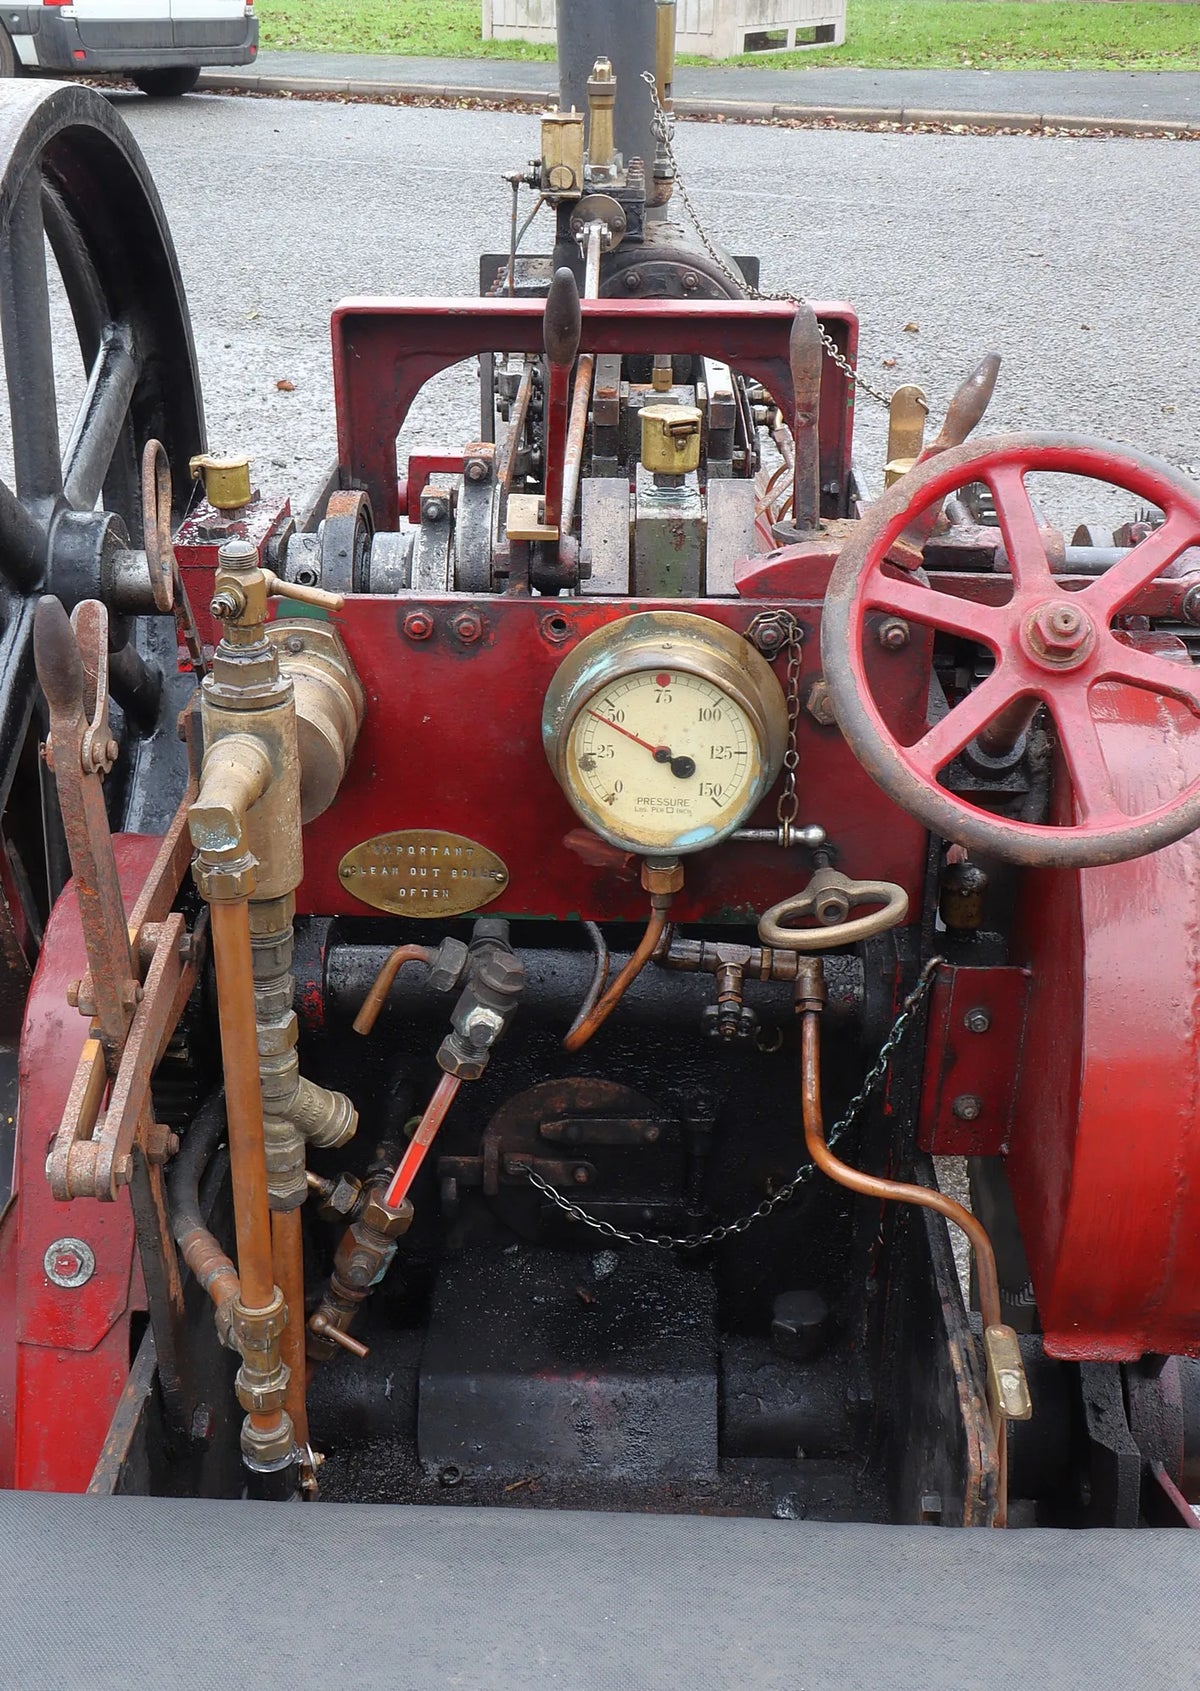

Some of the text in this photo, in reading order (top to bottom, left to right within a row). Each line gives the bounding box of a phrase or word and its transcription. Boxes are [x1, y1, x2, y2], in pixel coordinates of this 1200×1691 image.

[654, 689, 673, 704] 75
[607, 708, 625, 723] 50
[698, 708, 722, 722] 100
[597, 744, 615, 759] 25
[709, 745, 733, 760] 125
[614, 780, 623, 793] 0
[698, 782, 723, 798] 150
[637, 797, 691, 807] PRESSURE
[409, 867, 441, 878] OUT
[399, 888, 450, 898] OFTEN
